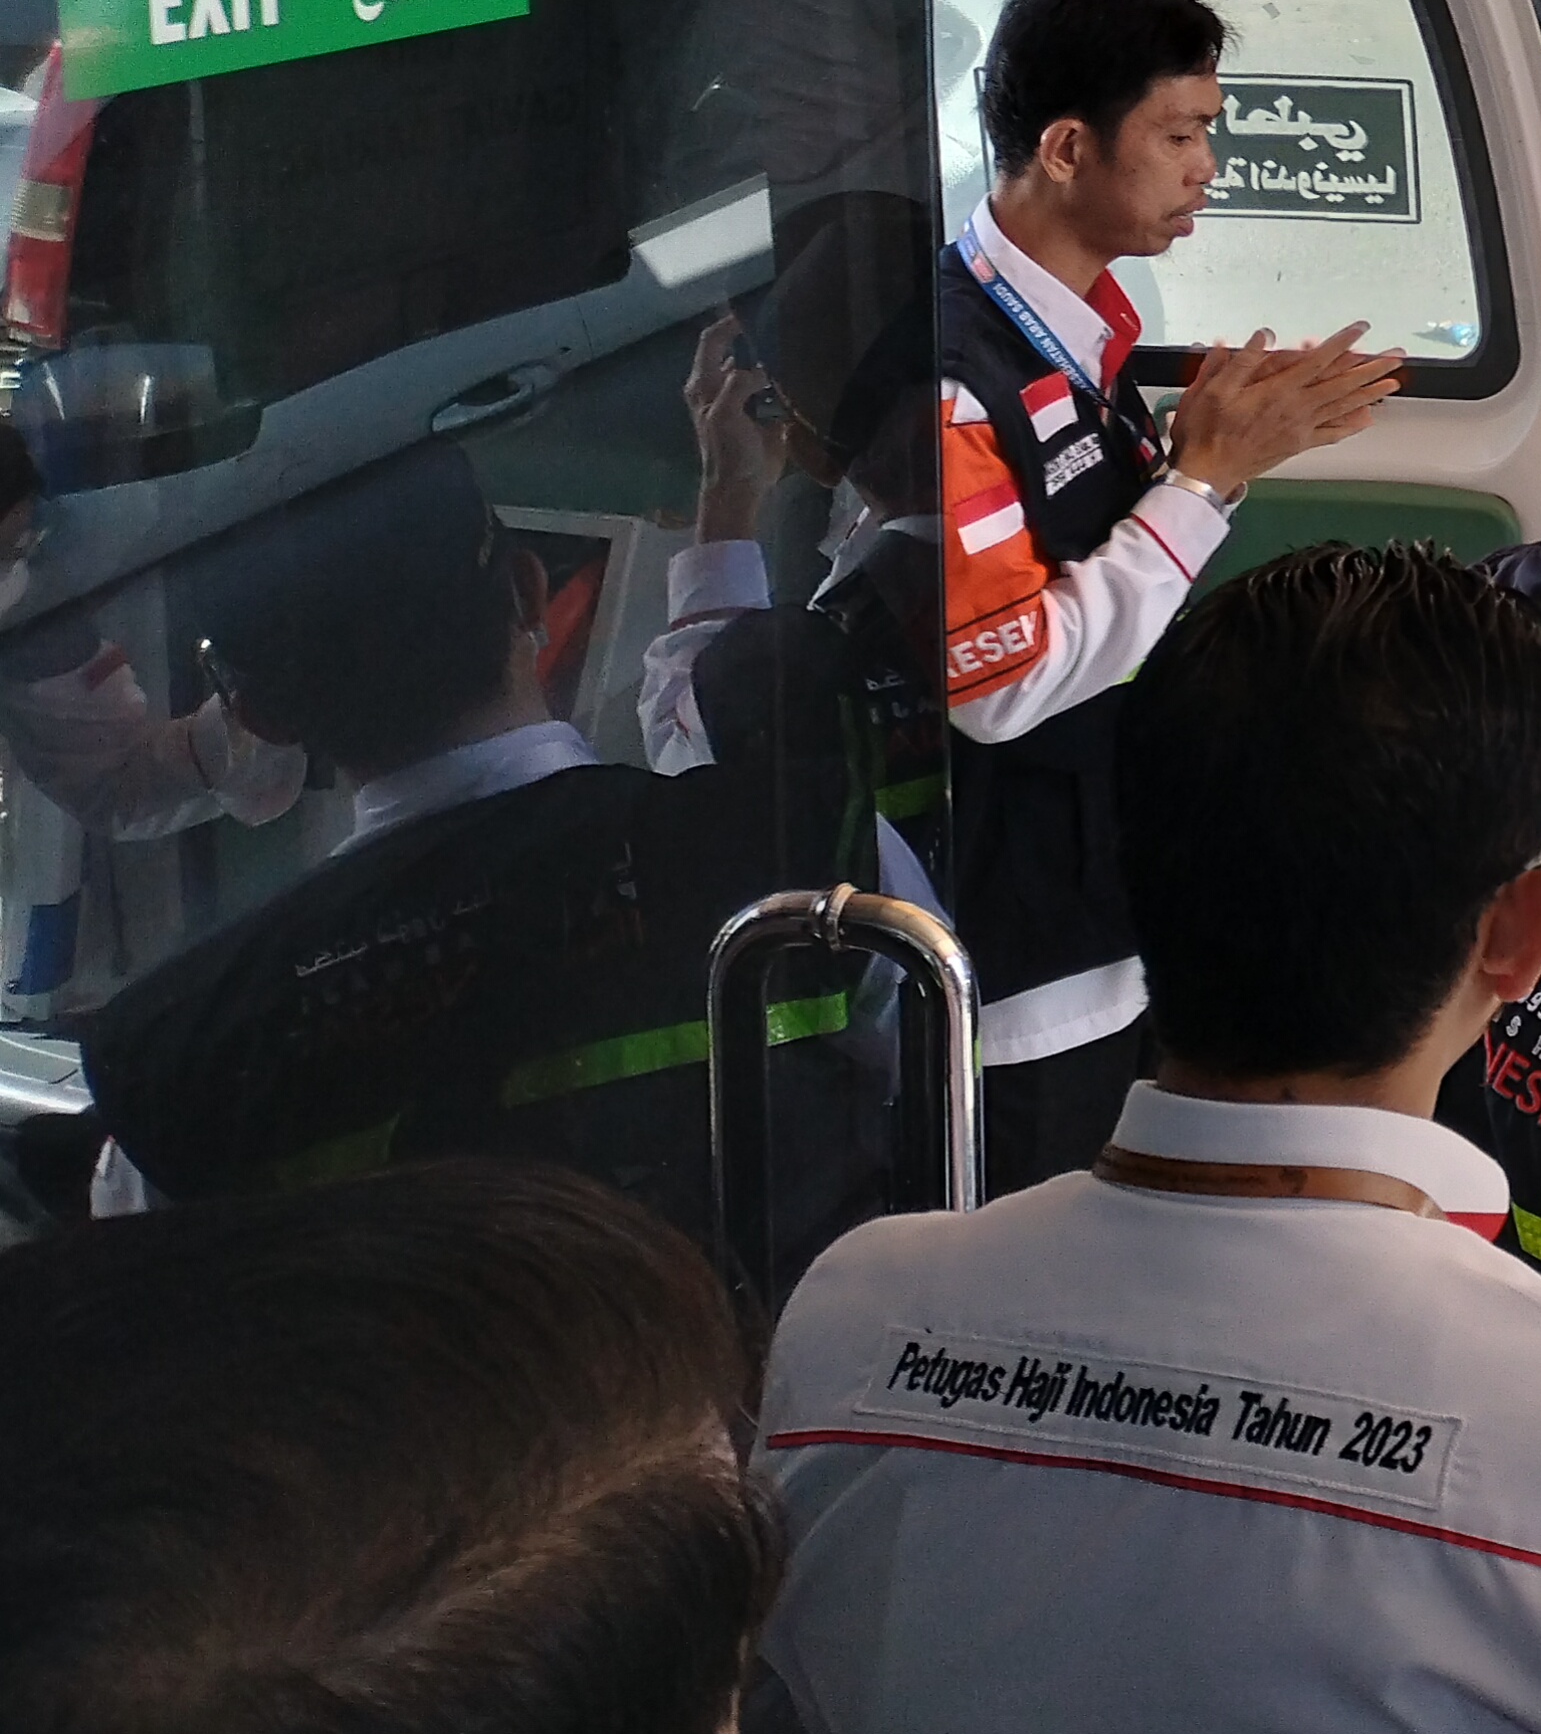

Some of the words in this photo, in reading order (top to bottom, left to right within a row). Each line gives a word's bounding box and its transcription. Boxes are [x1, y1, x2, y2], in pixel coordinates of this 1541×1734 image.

[993, 282, 1024, 313] SAUDI
[1018, 310, 1048, 338] ARAB
[887, 1341, 1006, 1409] Petugas
[1003, 1356, 1071, 1424] Haji
[1065, 1364, 1220, 1437] Indonesia
[1230, 1390, 1332, 1457] Tahun
[1339, 1411, 1433, 1474] 2023
